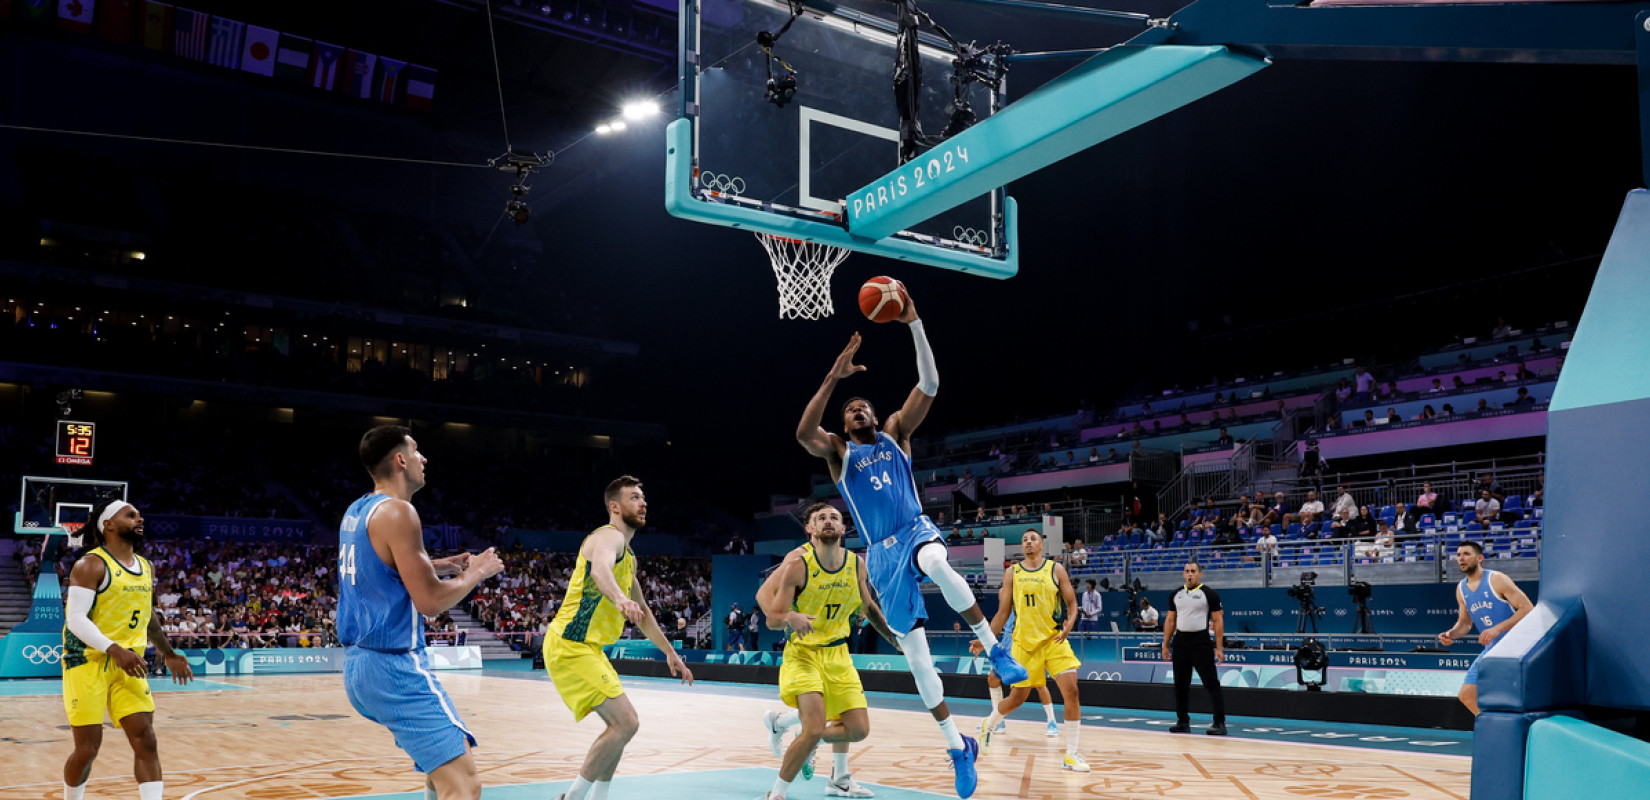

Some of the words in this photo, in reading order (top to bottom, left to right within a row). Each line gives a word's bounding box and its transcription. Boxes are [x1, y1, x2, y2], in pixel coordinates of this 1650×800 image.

[914, 145, 969, 188] 2024
[67, 424, 92, 436] 5:35
[70, 437, 90, 455] 12
[854, 450, 893, 472] HELLAS
[870, 470, 893, 491] 34
[209, 524, 257, 536] PARIS
[262, 526, 304, 538] 2024
[1024, 593, 1036, 607] 11
[824, 603, 842, 620] 17
[128, 610, 141, 630] 5
[1480, 615, 1494, 628] 16
[259, 655, 294, 664] PARIS
[298, 654, 329, 663] 2024
[1135, 651, 1155, 659] PARIS
[1223, 654, 1247, 662] 2024
[1269, 654, 1295, 663] PARIS
[1349, 656, 1378, 666] PARIS
[1380, 657, 1408, 666] 2024
[1439, 658, 1470, 668] PARIS
